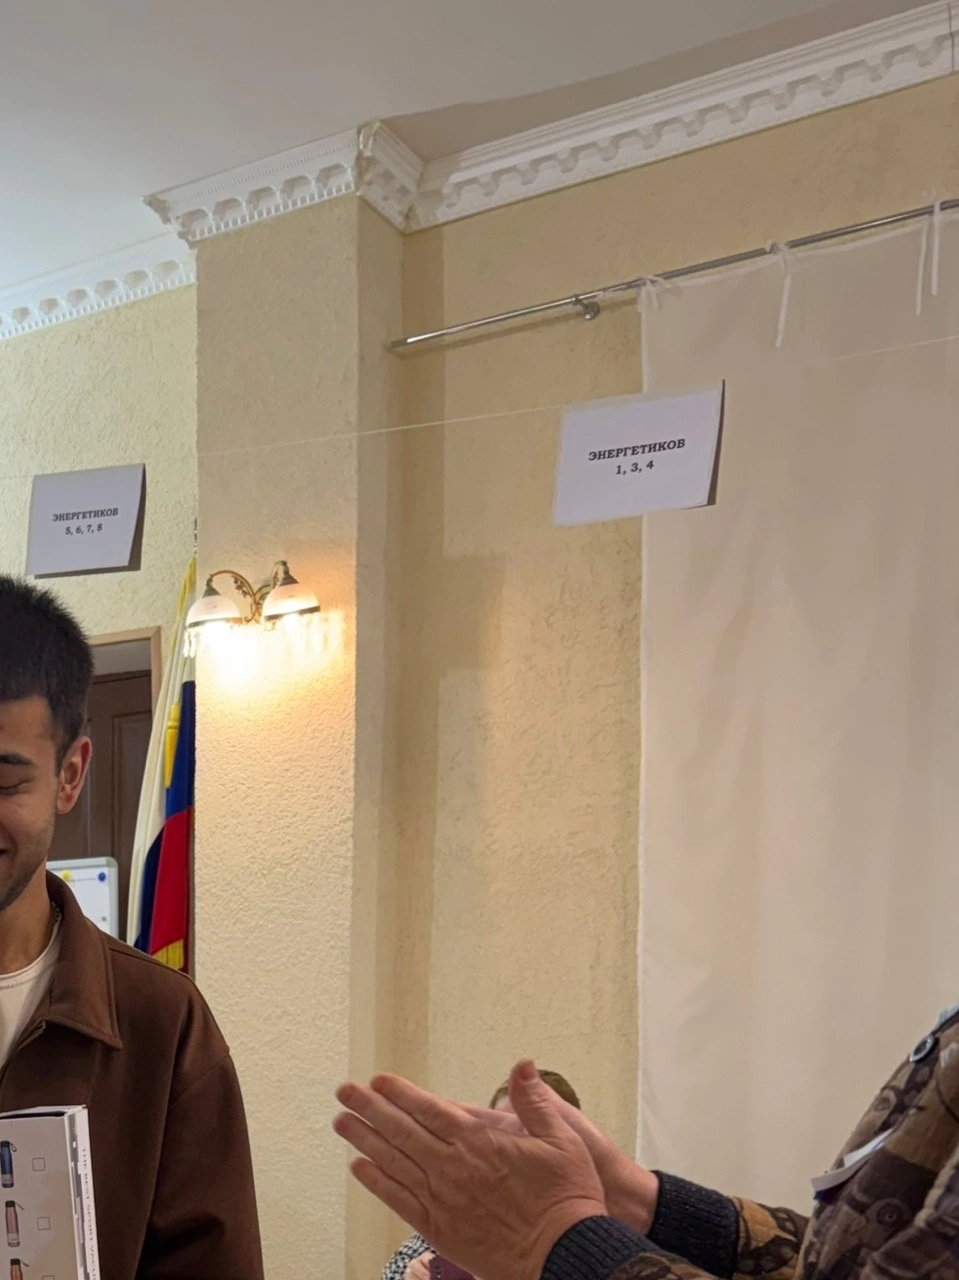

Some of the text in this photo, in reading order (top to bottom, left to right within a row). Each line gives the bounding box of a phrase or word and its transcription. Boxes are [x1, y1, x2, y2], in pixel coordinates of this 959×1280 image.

[588, 438, 686, 461] ЭНЕРГЕТИКОВ
[616, 460, 654, 475] 1, 3, 4
[52, 508, 119, 522] ЭНЕРГЕТИКОВ
[65, 523, 103, 535] 5, 6, 7, 8
